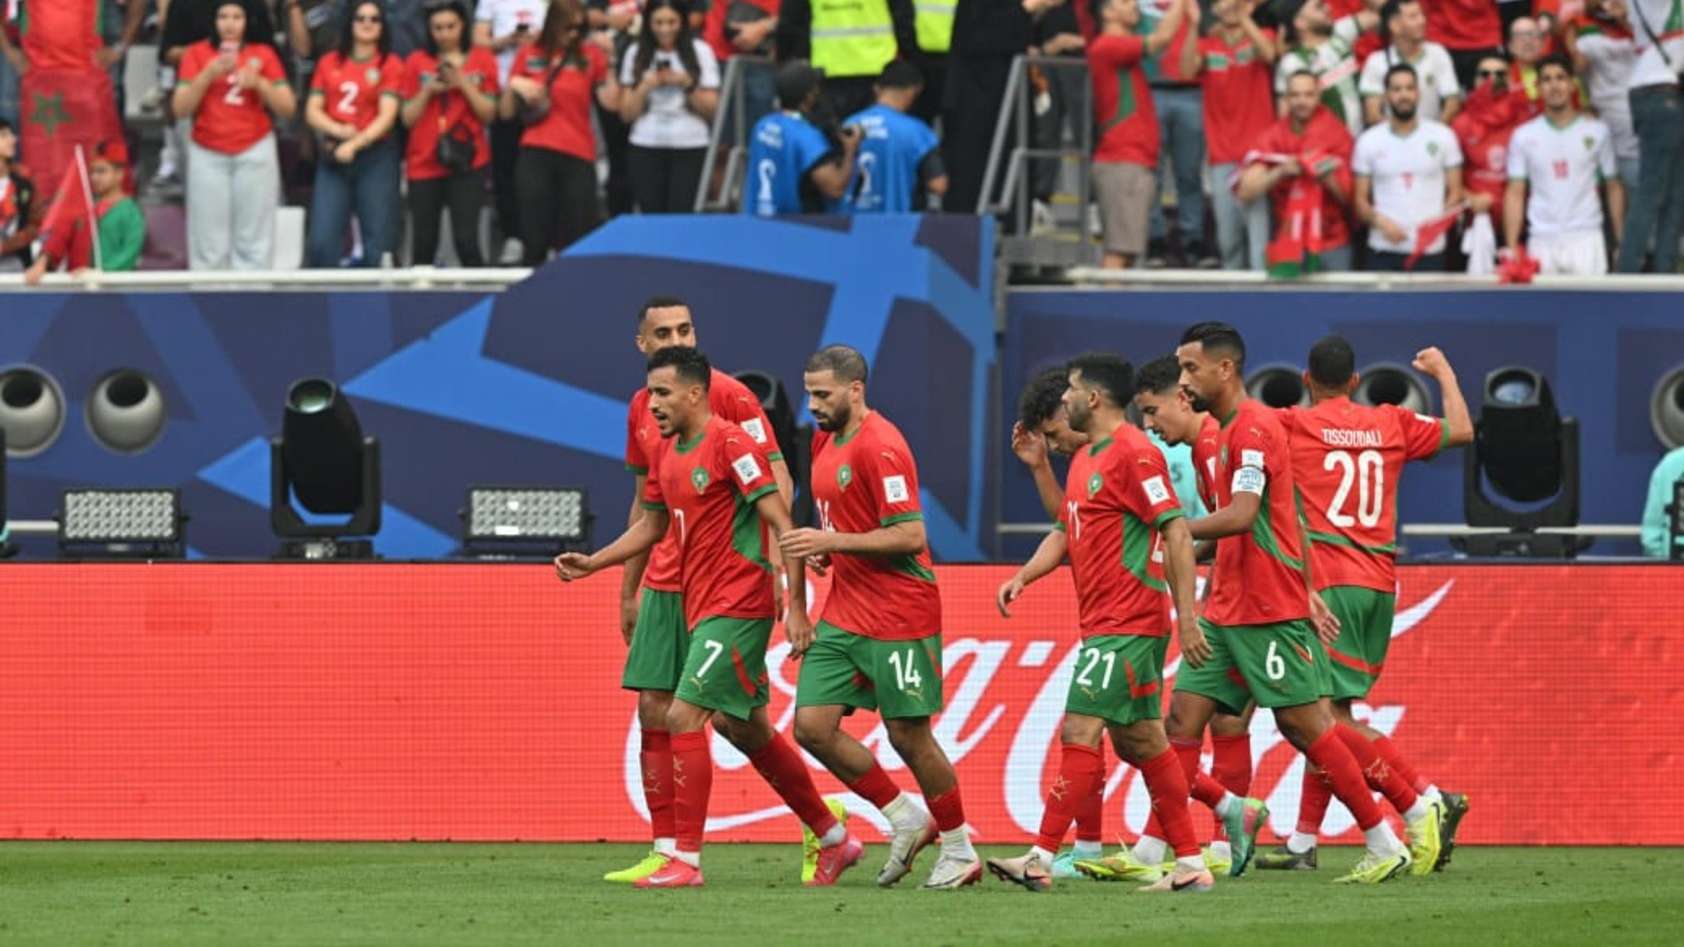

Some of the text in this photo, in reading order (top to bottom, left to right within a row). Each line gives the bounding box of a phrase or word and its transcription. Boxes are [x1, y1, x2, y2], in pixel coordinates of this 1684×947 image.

[337, 80, 359, 114] 2
[1321, 428, 1383, 448] TISSOUDALI
[1323, 449, 1384, 528] 20
[698, 640, 723, 678] 7
[888, 648, 922, 689] 14
[1076, 647, 1117, 690] 21
[1266, 641, 1285, 680] 6
